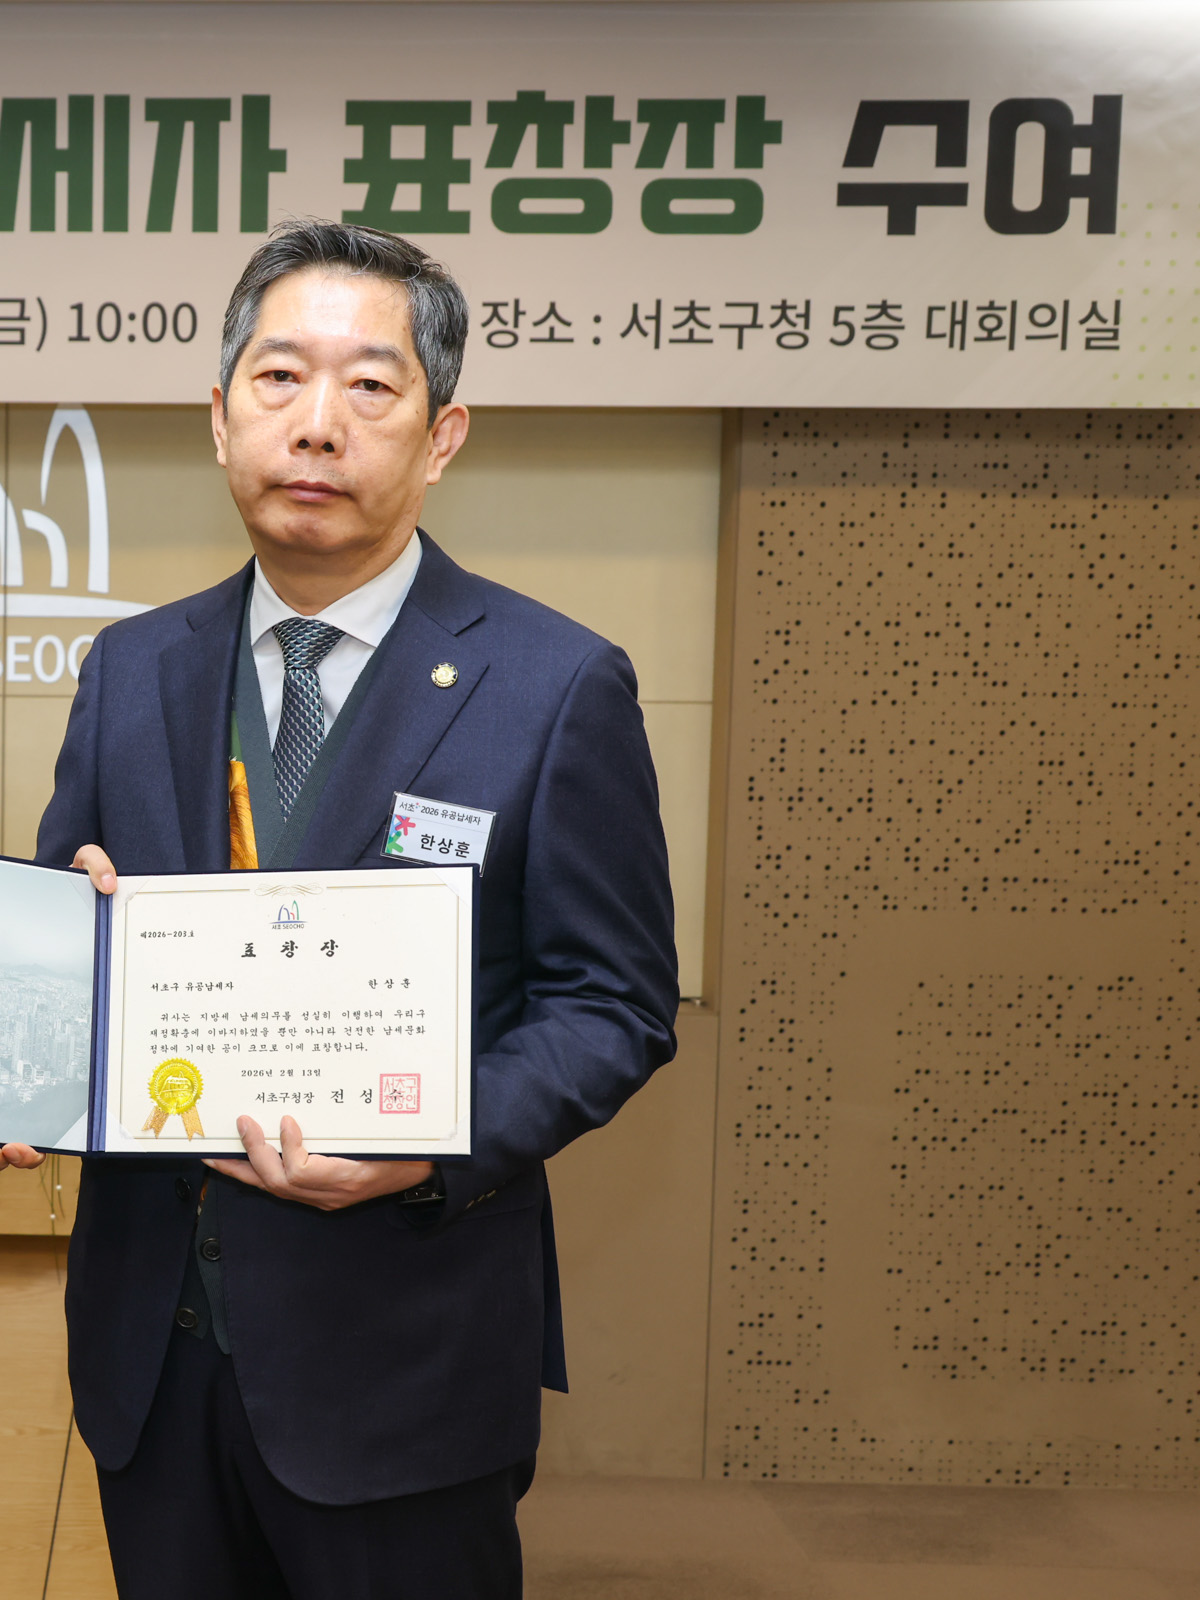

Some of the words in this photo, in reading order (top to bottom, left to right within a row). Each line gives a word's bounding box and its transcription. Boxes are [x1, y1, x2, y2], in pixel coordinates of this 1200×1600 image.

[341, 90, 783, 234] 표창장
[837, 95, 1122, 235] 수여
[68, 302, 197, 343] 10:00
[481, 299, 574, 348] 장소
[620, 299, 810, 350] 서초구청
[830, 300, 905, 350] 5층
[926, 300, 1120, 351] 대회의실
[400, 801, 415, 812] 서초
[421, 806, 439, 816] 2026
[441, 809, 481, 825] 유공납세자
[420, 834, 470, 858] 한상훈
[283, 922, 305, 930] SEOCHO
[151, 983, 179, 992] 서초구
[160, 1013, 191, 1023] 귀사는
[200, 1013, 229, 1023] 지방세
[301, 1011, 331, 1022] 성실히
[341, 1010, 383, 1021] 이행하여
[393, 1010, 425, 1019] 우리구
[304, 1027, 336, 1036] 아니라
[150, 1045, 178, 1055] 정착에
[185, 1044, 216, 1054] 기여한
[221, 1044, 241, 1054] 공이
[248, 1044, 279, 1053] 크므로
[284, 1043, 304, 1052] 이에
[311, 1042, 368, 1053] 표창합니다.
[241, 1069, 273, 1077] 2026년
[279, 1069, 294, 1077] 2월
[302, 1069, 321, 1077] 13일
[255, 1092, 315, 1104] 서초구청장
